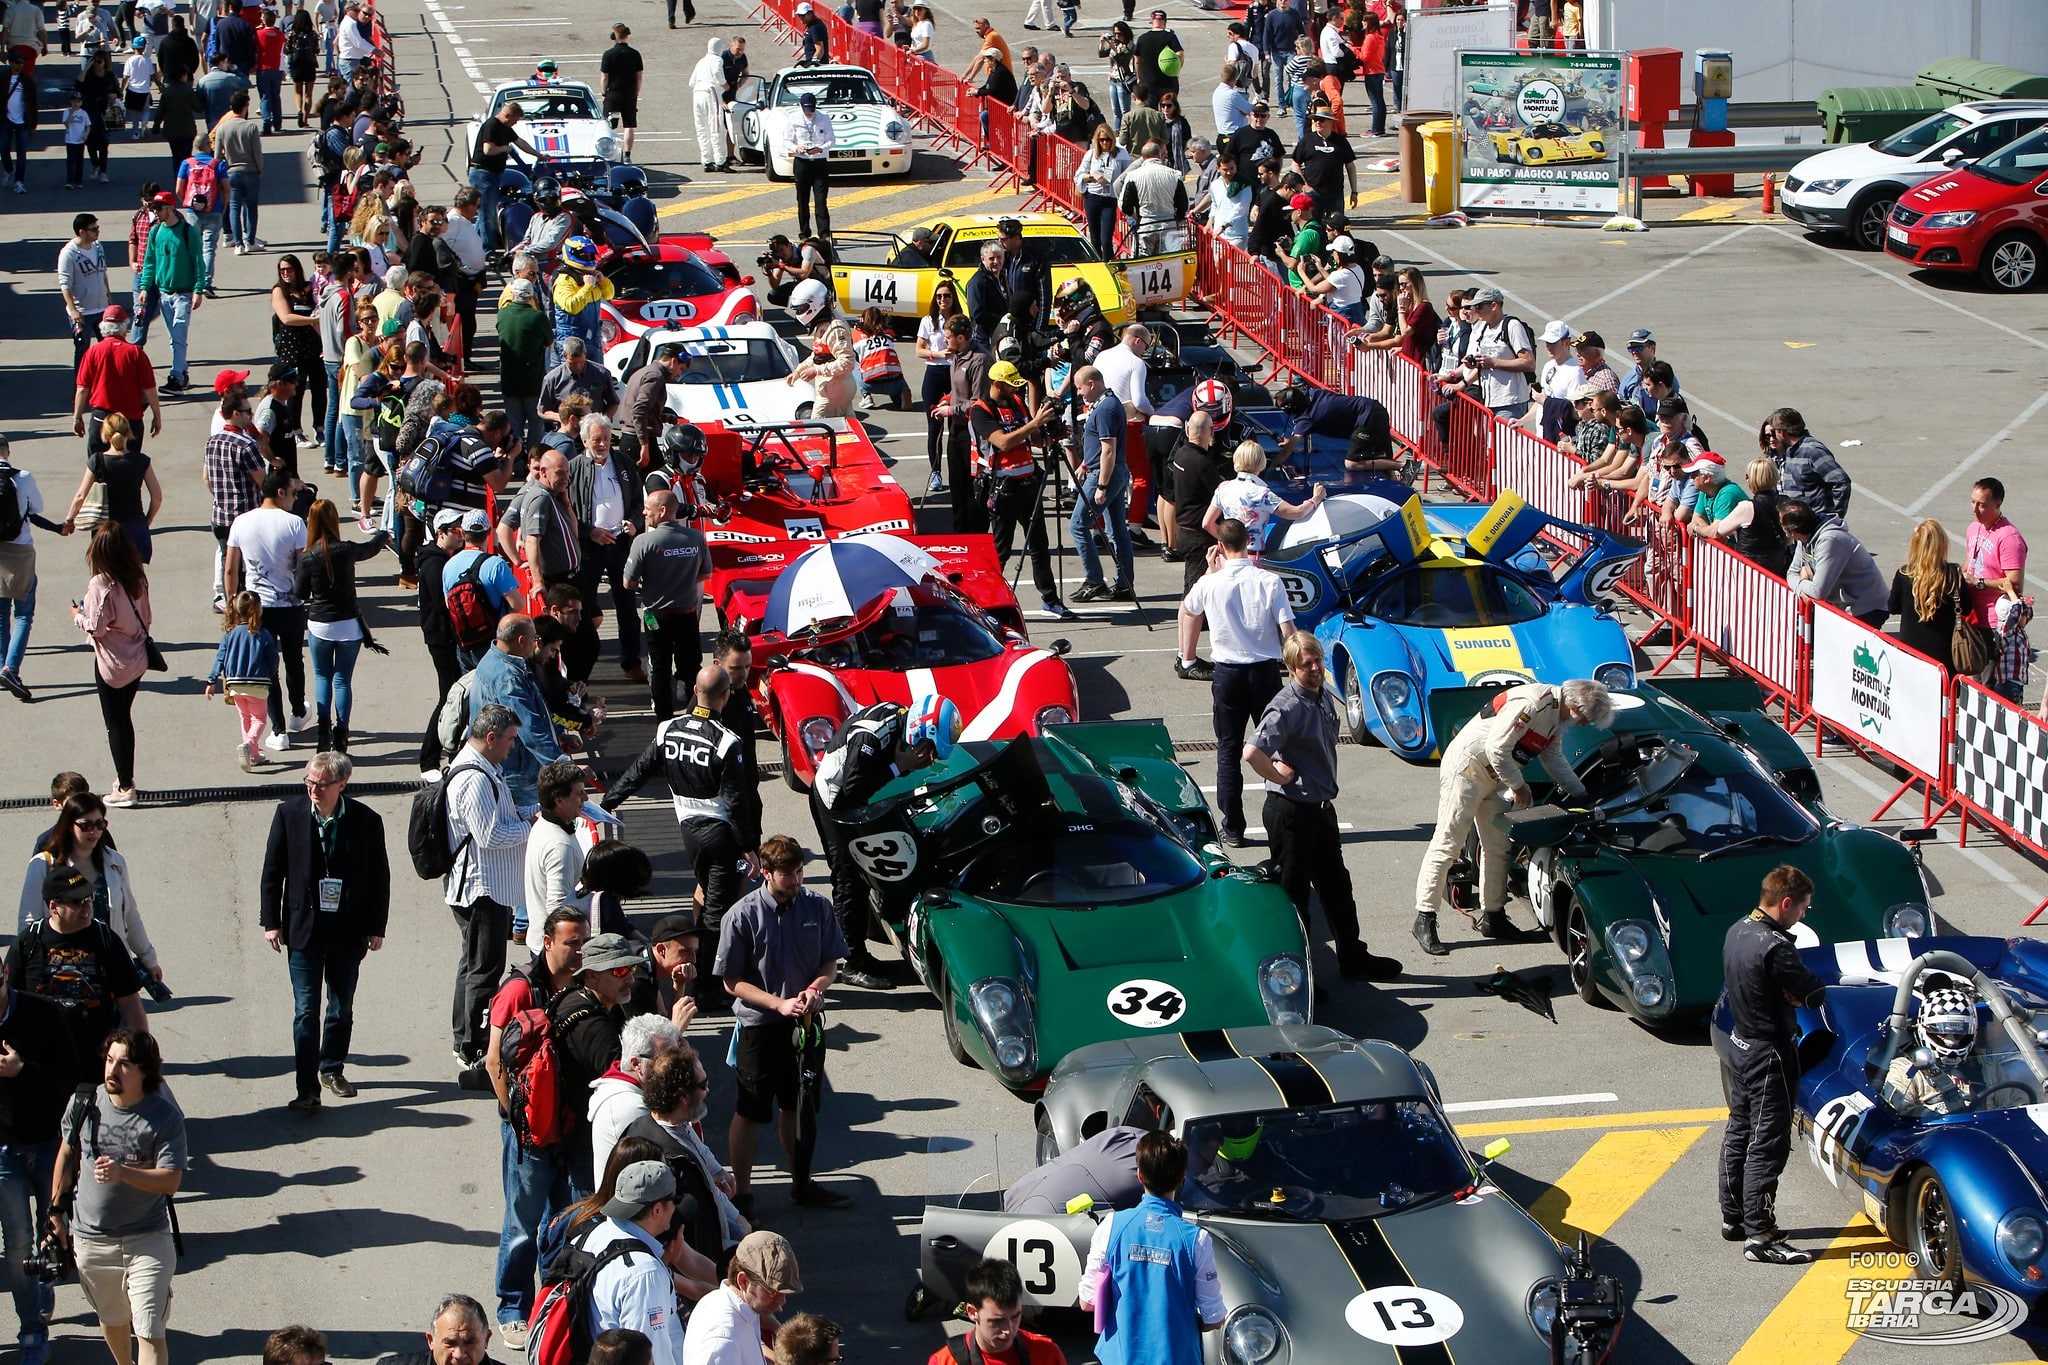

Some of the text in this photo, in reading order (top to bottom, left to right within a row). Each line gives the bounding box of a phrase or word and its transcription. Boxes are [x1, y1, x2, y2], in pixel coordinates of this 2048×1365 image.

[787, 73, 869, 81] TUTHILLPORSCHE.COM
[745, 116, 758, 136] 74
[1470, 166, 1610, 181] UN PASO MÁGICO AL PASADO
[1141, 268, 1172, 296] 144
[865, 278, 898, 304] 144
[649, 304, 691, 318] 170
[866, 335, 890, 350] 292
[723, 413, 757, 425] 19
[1489, 505, 1515, 536] DONOVAN
[788, 524, 823, 539] 25
[663, 546, 699, 557] GIBSON
[737, 553, 785, 563] GIBSON
[1454, 639, 1511, 650] SUNOCO
[1883, 684, 1891, 700] DE
[664, 740, 711, 767] DHG
[1067, 824, 1094, 832] DHG
[855, 839, 908, 878] 34
[1111, 986, 1183, 1021] 34
[1007, 1237, 1057, 1295] 13
[1372, 1297, 1436, 1331] 13
